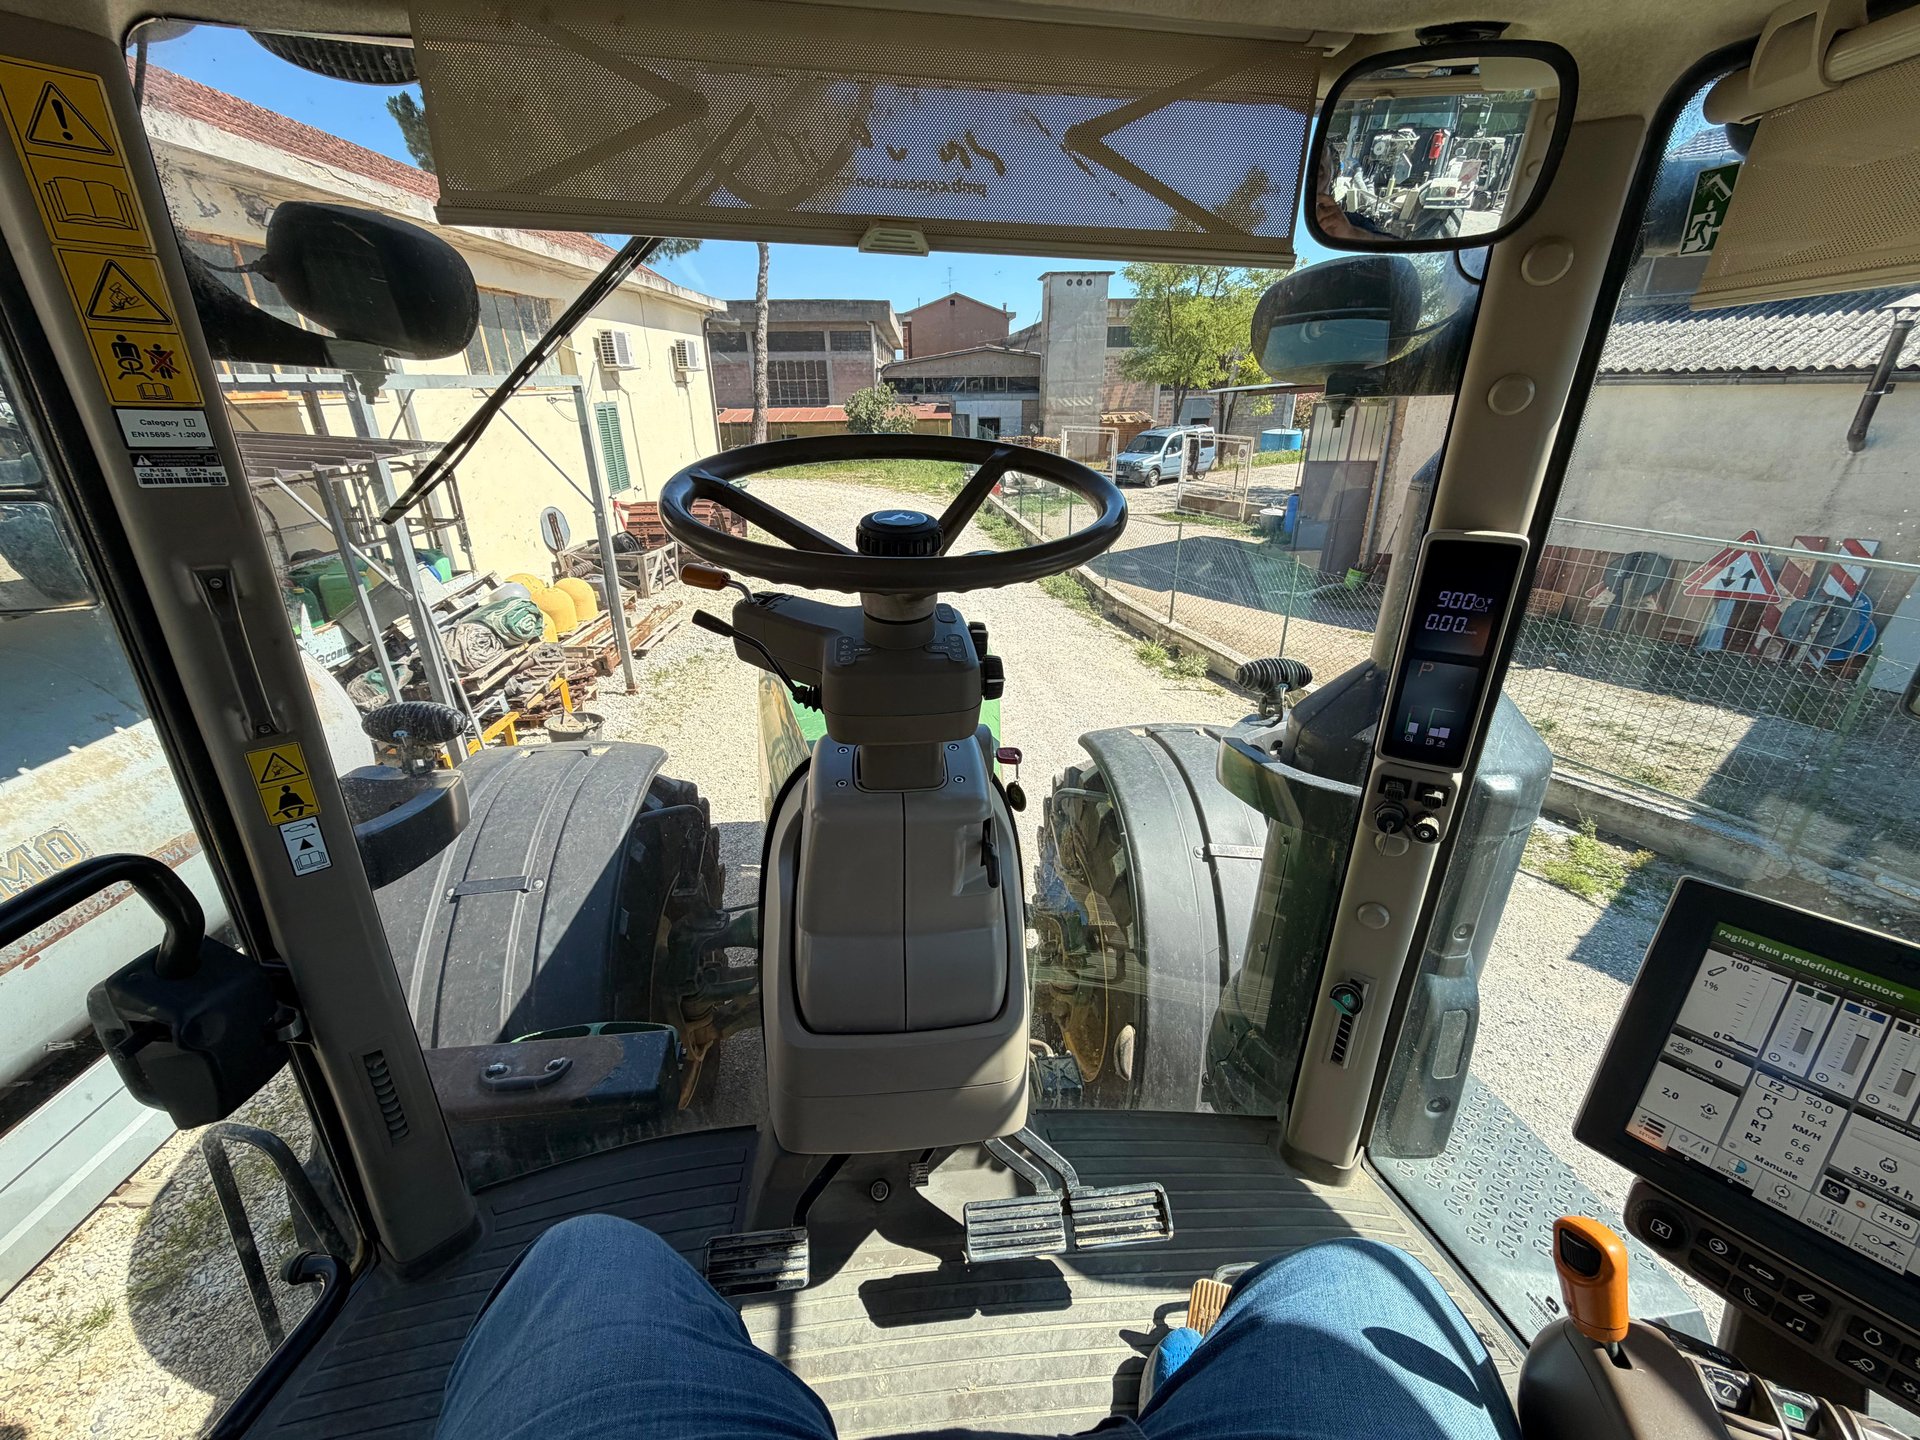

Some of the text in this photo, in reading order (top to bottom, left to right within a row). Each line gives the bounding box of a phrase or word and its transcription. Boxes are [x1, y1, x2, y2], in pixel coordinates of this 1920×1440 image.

[140, 419, 179, 428] Category
[1437, 591, 1476, 610] 900
[1425, 613, 1468, 633] 0.00
[1418, 661, 1434, 678] P
[1718, 929, 1905, 1000] Pagina Run predefinita trattore
[1730, 960, 1750, 973] 100
[1703, 980, 1719, 992] 1%
[1813, 981, 1827, 989] SCV
[1713, 1031, 1720, 1039] 0
[1714, 1060, 1723, 1069] 0
[1768, 1080, 1785, 1094] F2
[1763, 1093, 1778, 1106] F1
[1804, 1096, 1834, 1115] 50.0
[1700, 1113, 1713, 1121] bar
[1800, 1110, 1828, 1128] 16.4
[1750, 1119, 1767, 1133] R1
[1792, 1123, 1823, 1142] KM/H
[1744, 1132, 1762, 1146] R2
[1790, 1138, 1811, 1153] 6.6
[1784, 1151, 1805, 1167] 6.8
[1716, 1165, 1750, 1185] AUTOTRAC
[1754, 1154, 1799, 1181] Manuale
[1904, 1190, 1914, 1201] h
[1766, 1196, 1789, 1211] GUIDA
[1879, 1211, 1911, 1231] 2150
[1806, 1217, 1846, 1241] QUICK LINE
[1880, 1256, 1903, 1271] LINEA
